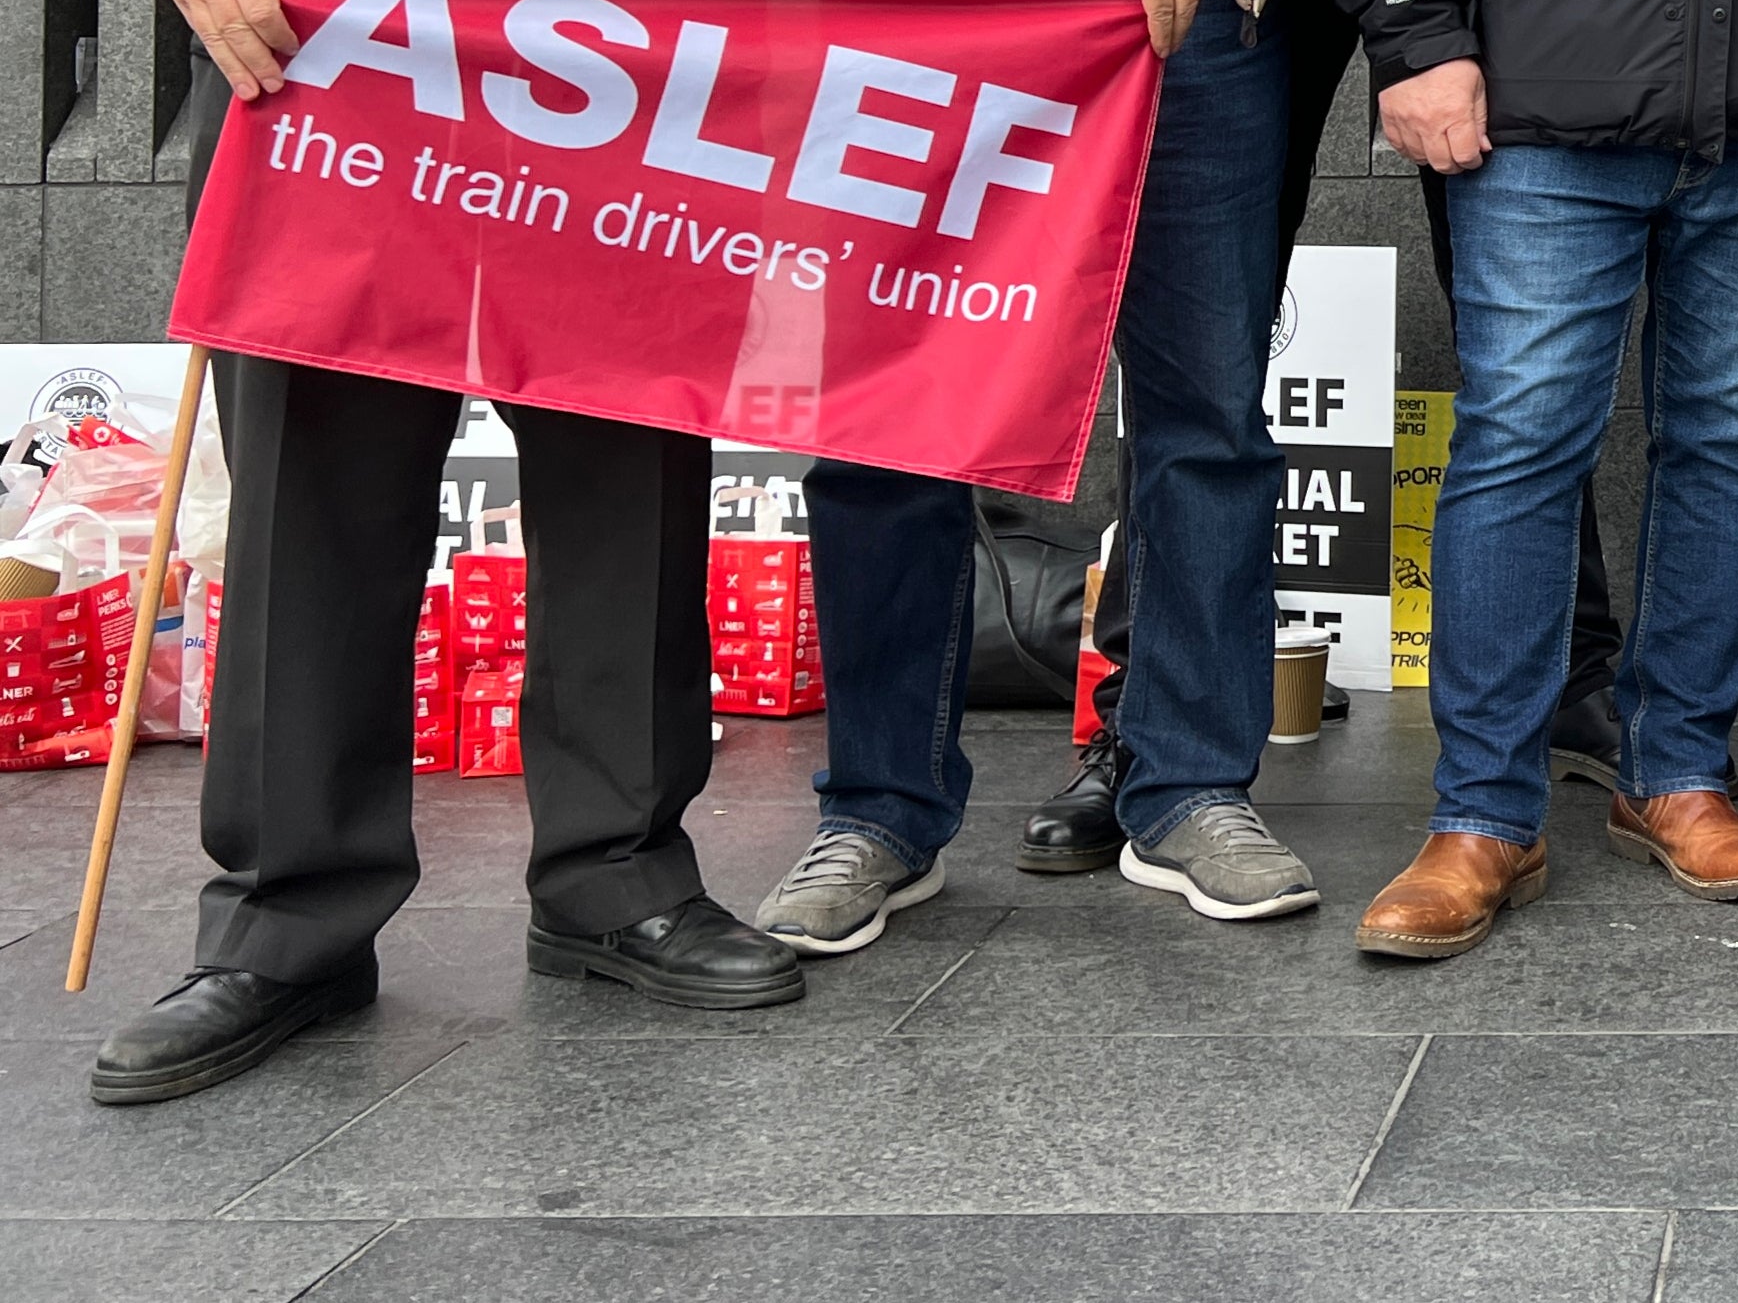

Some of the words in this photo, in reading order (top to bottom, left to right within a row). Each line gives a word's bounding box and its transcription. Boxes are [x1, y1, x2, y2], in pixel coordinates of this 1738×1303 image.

[270, 113, 384, 187] the
[412, 146, 568, 232] train
[868, 264, 1038, 322] union
[60, 372, 105, 385] ASLEF
[1266, 377, 1345, 428] EF
[0, 686, 33, 700] NER
